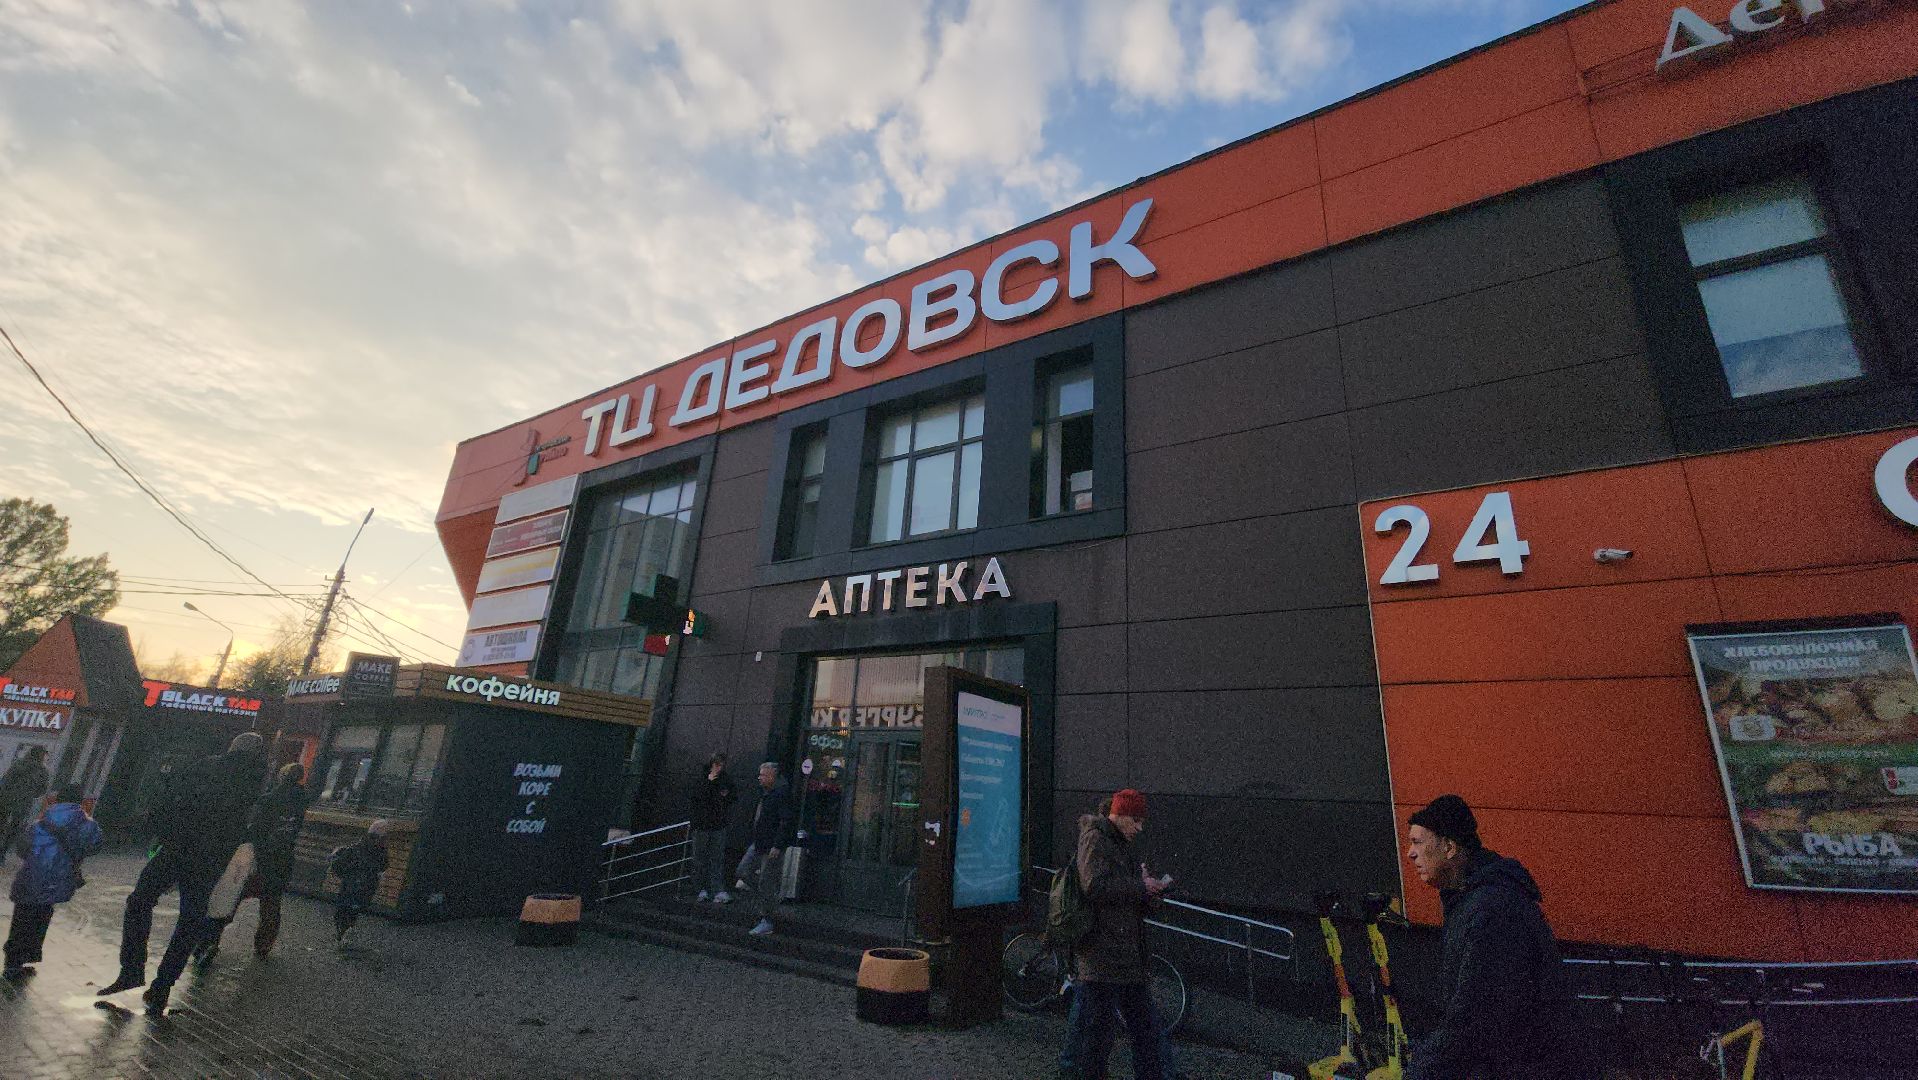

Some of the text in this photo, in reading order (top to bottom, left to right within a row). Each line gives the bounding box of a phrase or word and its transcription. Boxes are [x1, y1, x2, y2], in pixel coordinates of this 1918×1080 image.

[582, 198, 1156, 455] ТЦ ДЕДОВСК
[1374, 492, 1530, 585] 24
[808, 557, 1010, 618] АПТЕКА
[446, 674, 561, 706] кофейня
[513, 762, 563, 778] ВОЗЬМИ
[518, 782, 553, 796] КОФЕ
[525, 801, 536, 815] С
[505, 818, 547, 834] СОБОЙ
[1803, 831, 1903, 857] РЫБА
